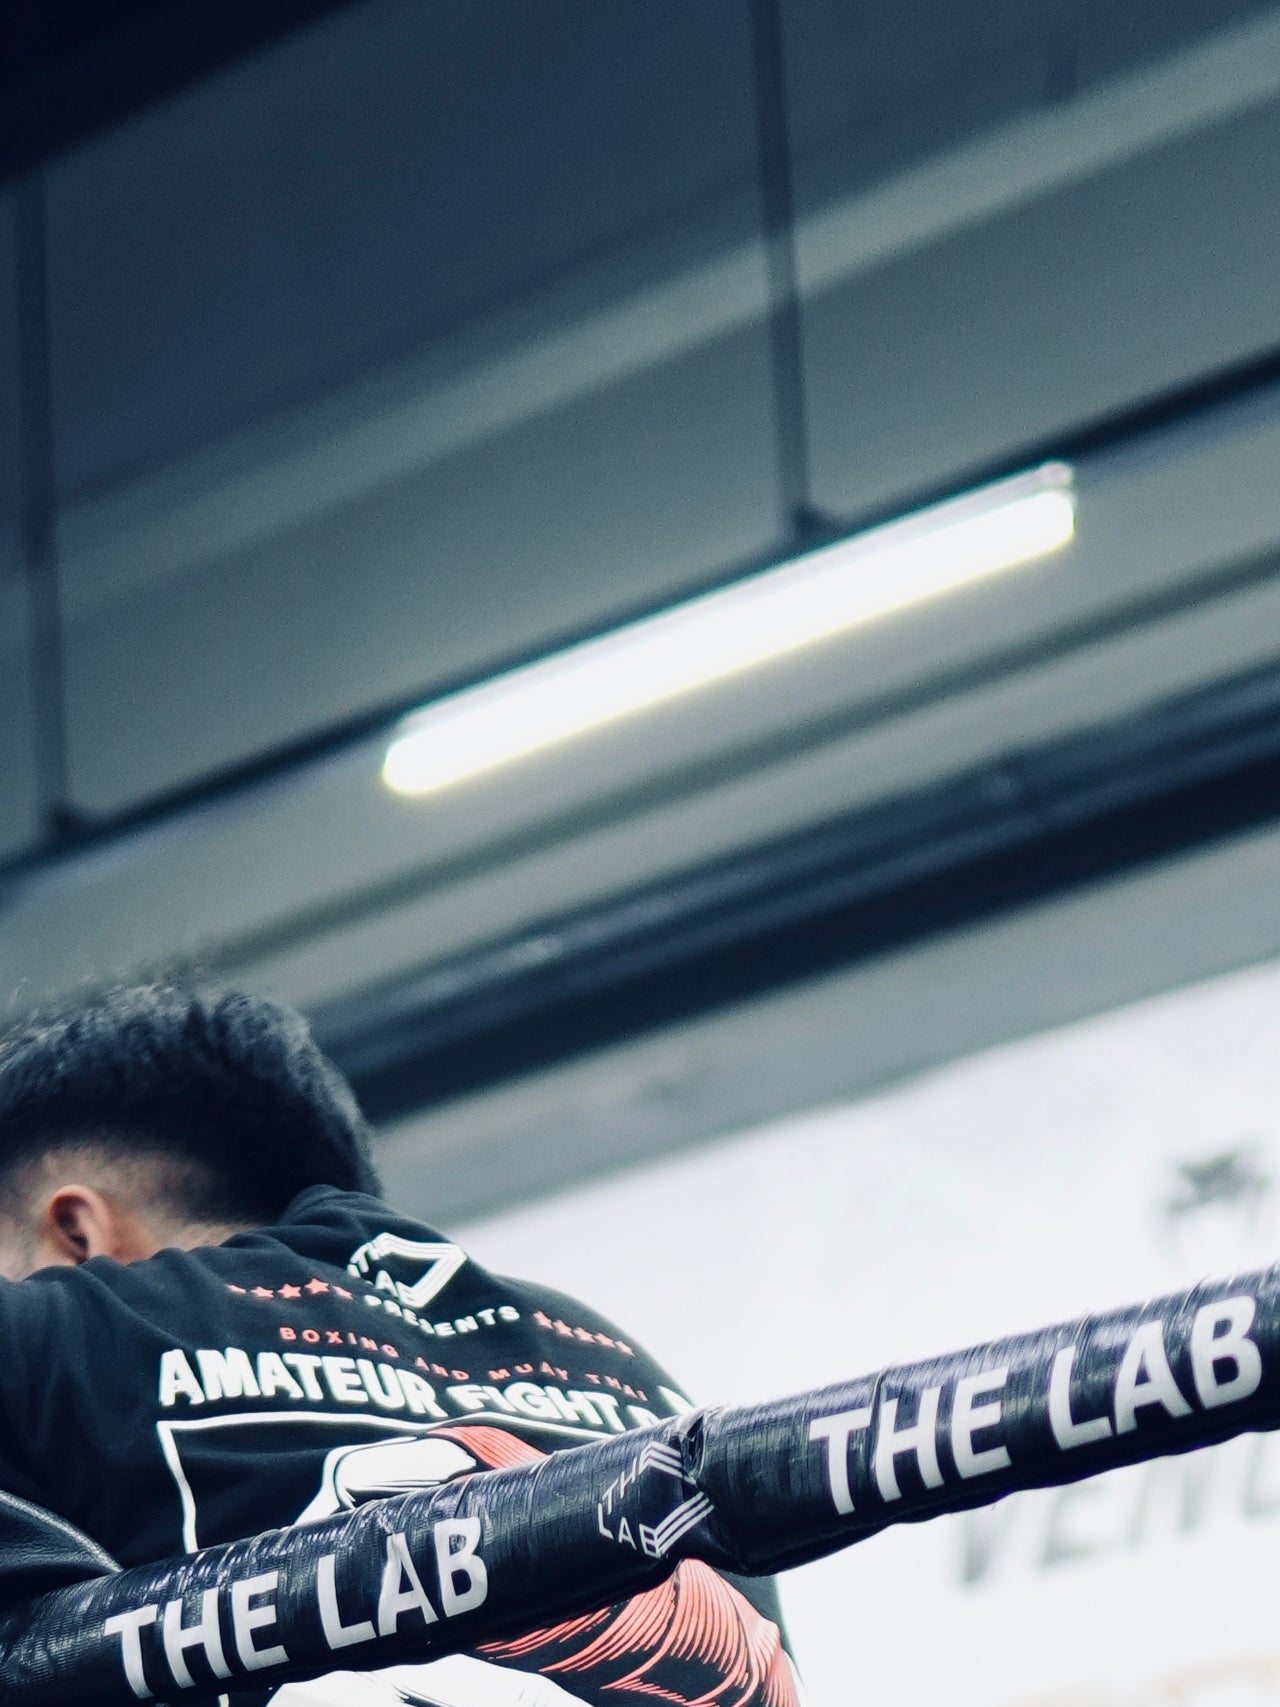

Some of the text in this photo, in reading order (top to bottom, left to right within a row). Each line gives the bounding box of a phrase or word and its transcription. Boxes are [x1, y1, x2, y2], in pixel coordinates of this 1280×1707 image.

[159, 1347, 448, 1418] AMATEUR
[446, 1381, 626, 1431] FIGHT
[279, 1327, 648, 1401] BOXING AND MUAY THAI
[811, 1295, 1262, 1516] THE LAB
[598, 1503, 661, 1558] LAB
[104, 1517, 489, 1699] THE LAB
